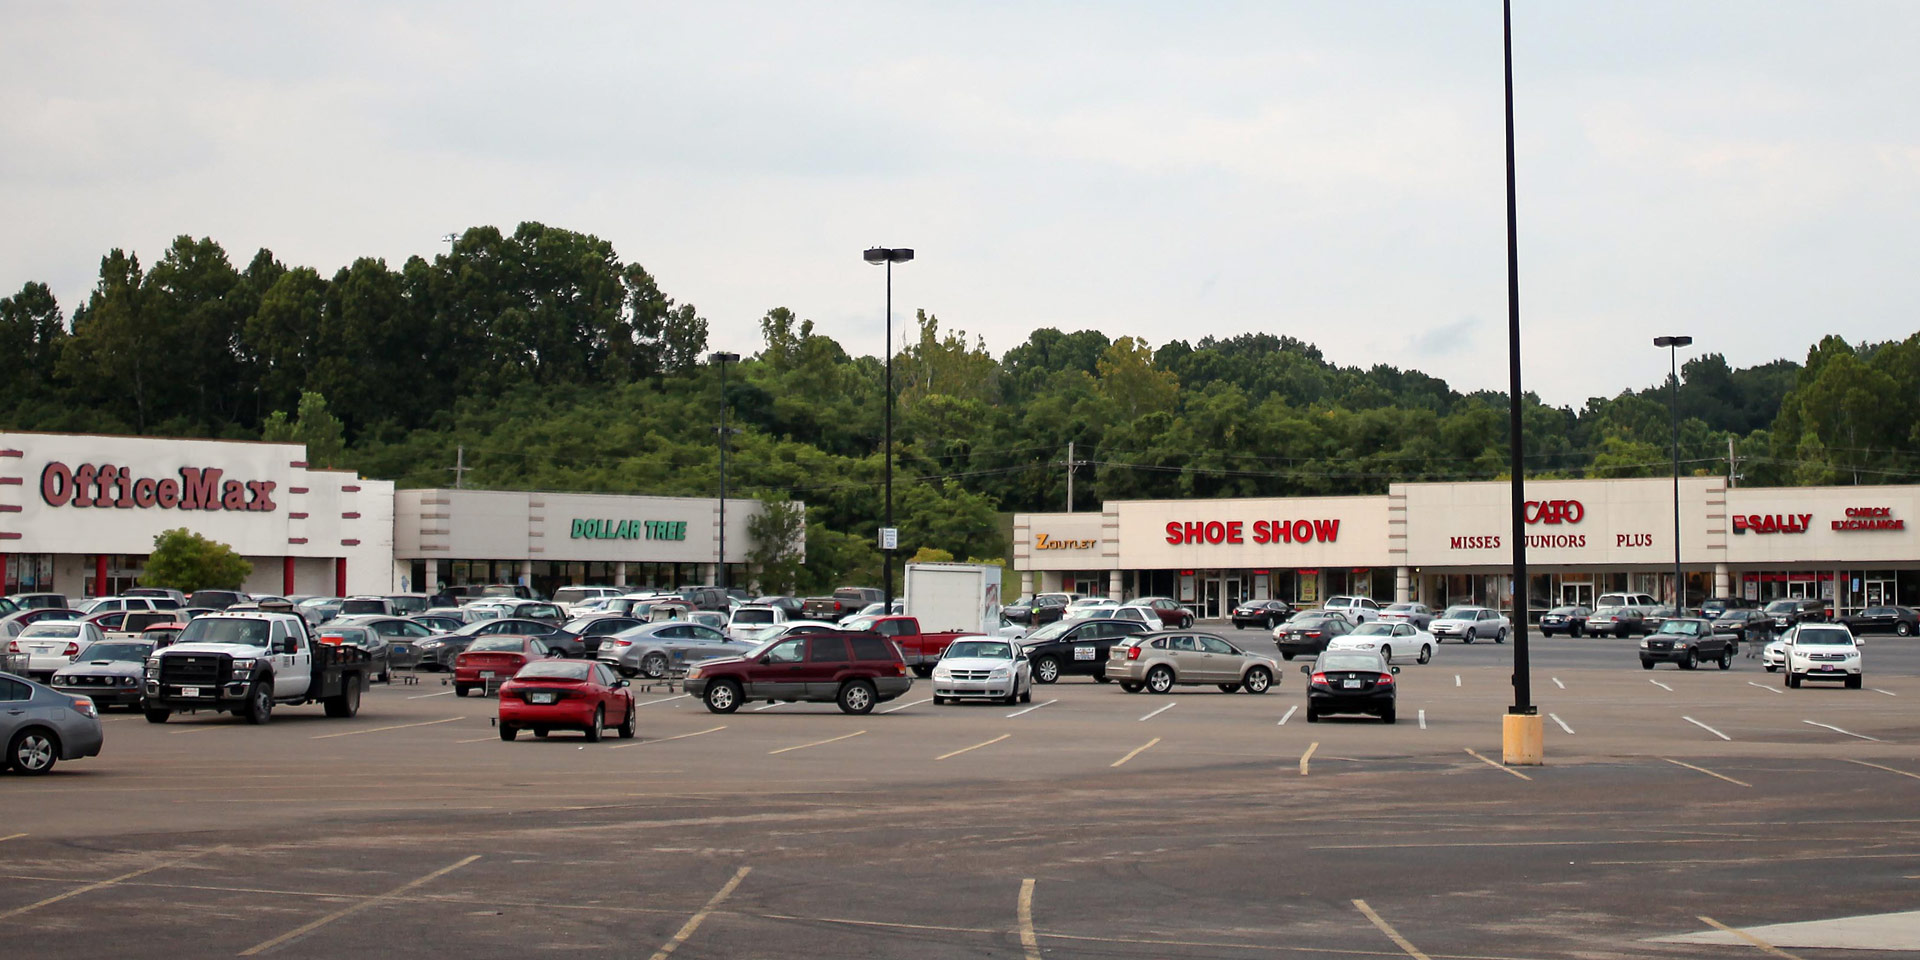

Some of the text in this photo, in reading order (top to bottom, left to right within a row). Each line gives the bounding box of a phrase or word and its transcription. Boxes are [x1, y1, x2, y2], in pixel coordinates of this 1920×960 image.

[40, 461, 277, 511] OfficeMax
[1523, 500, 1585, 525] CATO
[1748, 513, 1813, 530] SALLY
[1845, 507, 1891, 519] CHECK
[571, 518, 687, 541] DOLLAR TREE
[1165, 518, 1341, 545] SHOE SHOW
[1831, 519, 1906, 531] EXCHANGE
[1450, 535, 1501, 550] MISSES
[1616, 533, 1653, 547] PLUS
